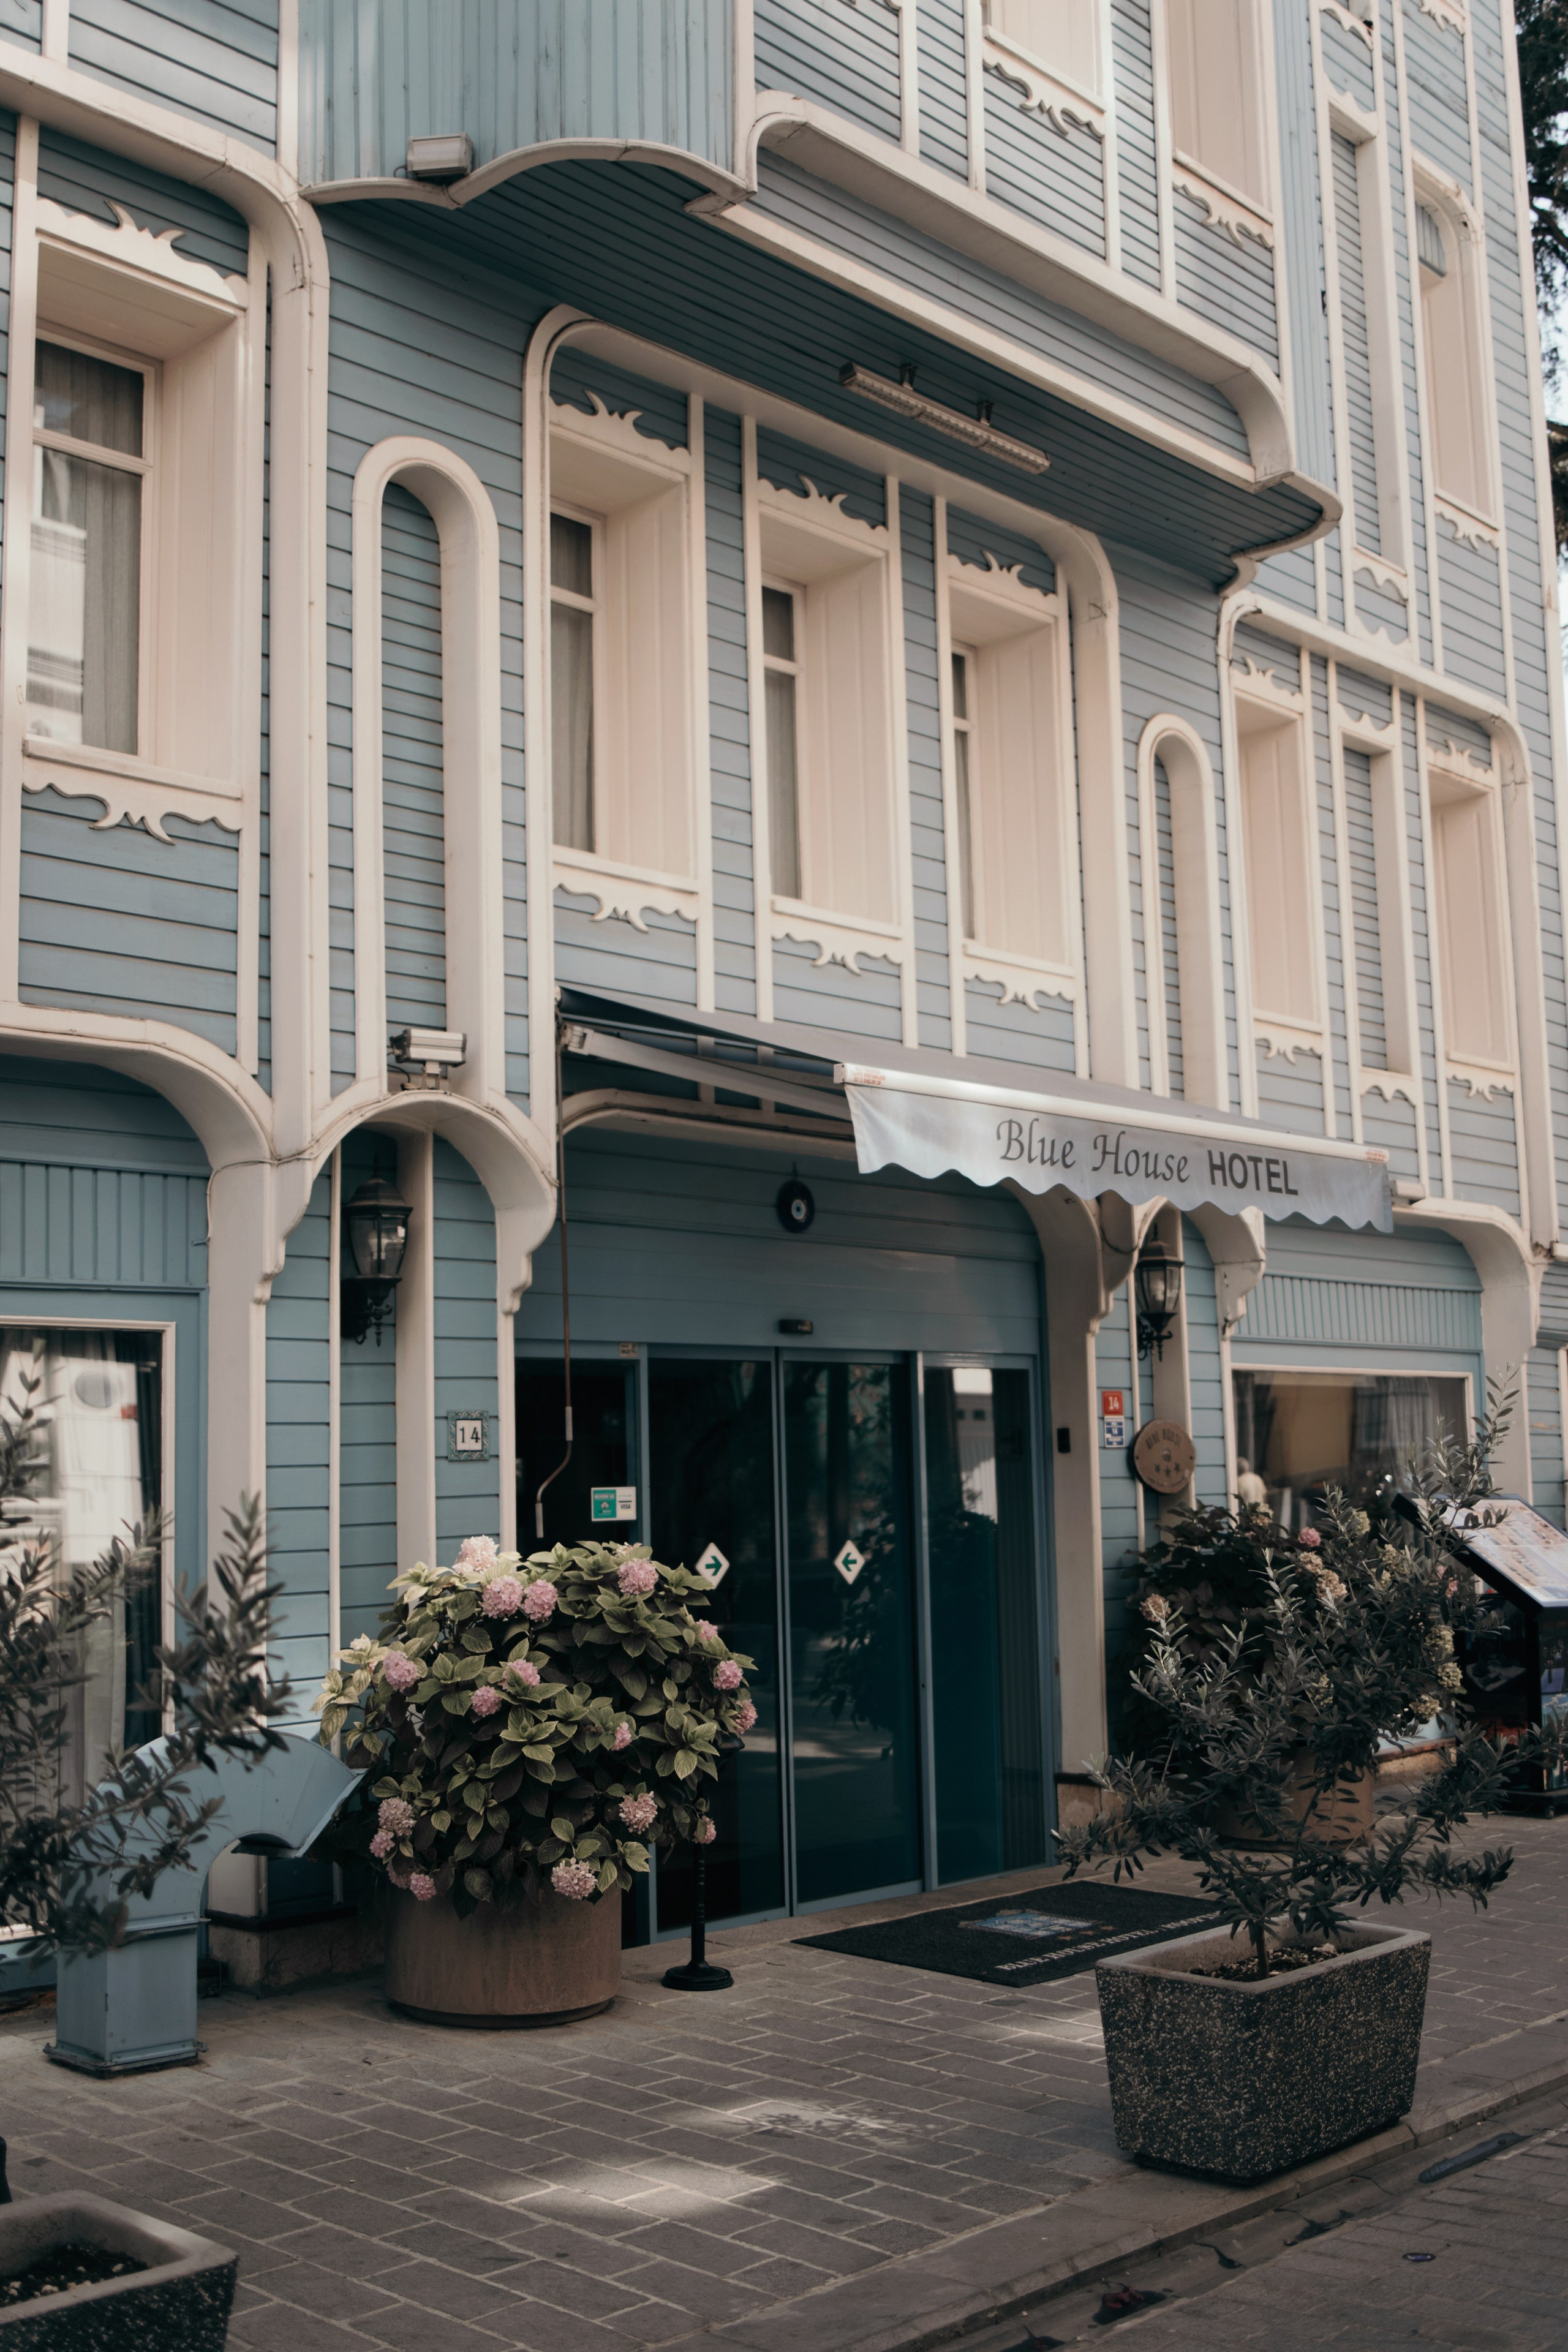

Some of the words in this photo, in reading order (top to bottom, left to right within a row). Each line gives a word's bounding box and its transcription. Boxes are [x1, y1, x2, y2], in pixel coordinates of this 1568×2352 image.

[997, 1118, 1076, 1169] Blue
[1091, 1131, 1189, 1183] House
[1207, 1150, 1298, 1195] HOTEL
[1109, 1396, 1119, 1410] 14
[459, 1427, 480, 1443] 14
[994, 1956, 1050, 1970] BLUE
[1042, 1941, 1106, 1959] HOUSE
[1099, 1928, 1159, 1945] HOTEL
